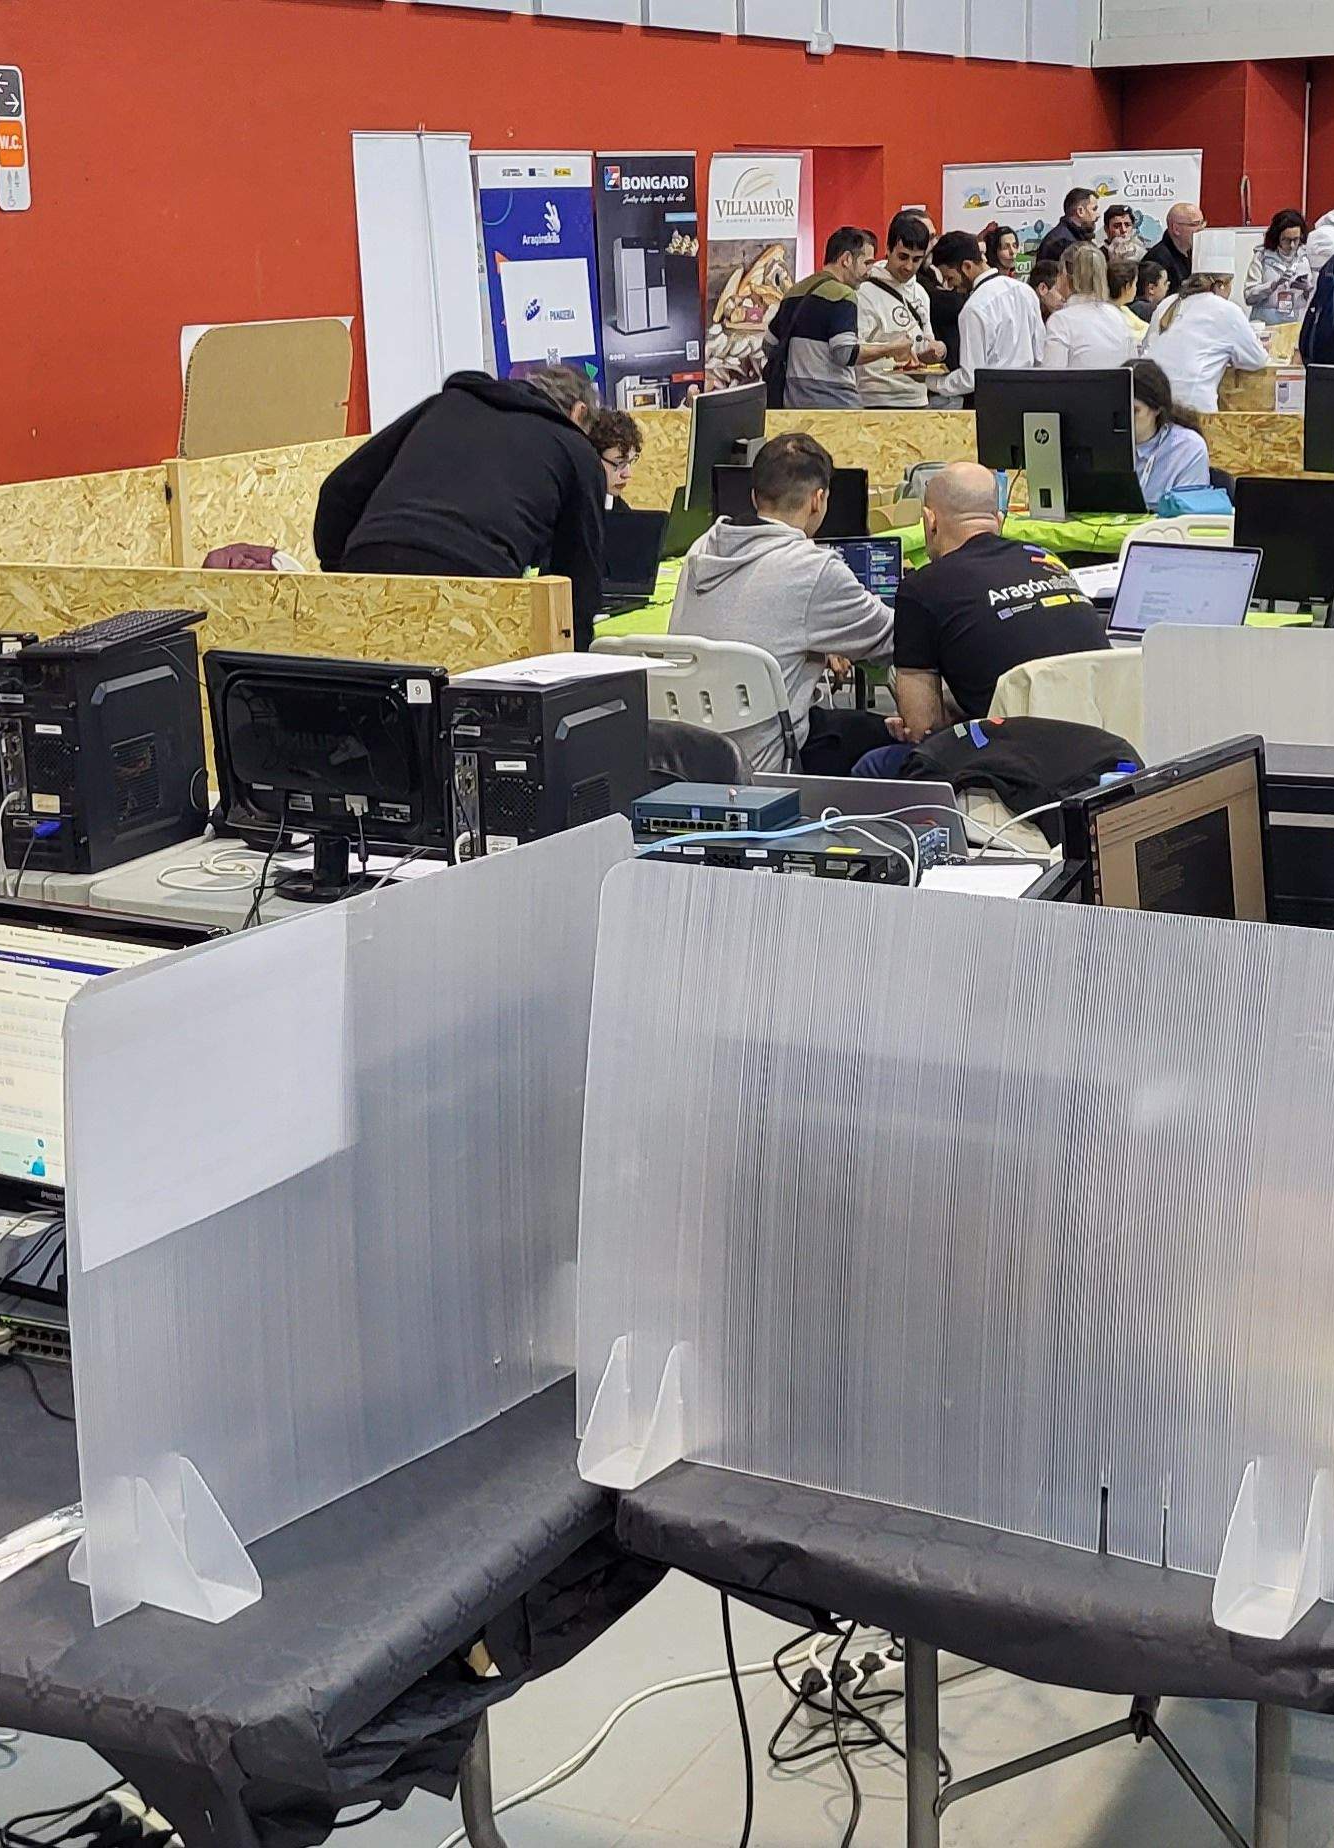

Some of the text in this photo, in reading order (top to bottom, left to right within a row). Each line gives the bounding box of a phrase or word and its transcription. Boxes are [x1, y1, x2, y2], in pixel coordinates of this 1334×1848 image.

[621, 175, 689, 190] BONGARD
[1122, 170, 1175, 184] Venta las
[995, 182, 1047, 195] Venta las
[1123, 184, 1175, 198] Cañadas
[714, 198, 795, 218] VILLAMAYOR
[995, 194, 1046, 208] Cañadas
